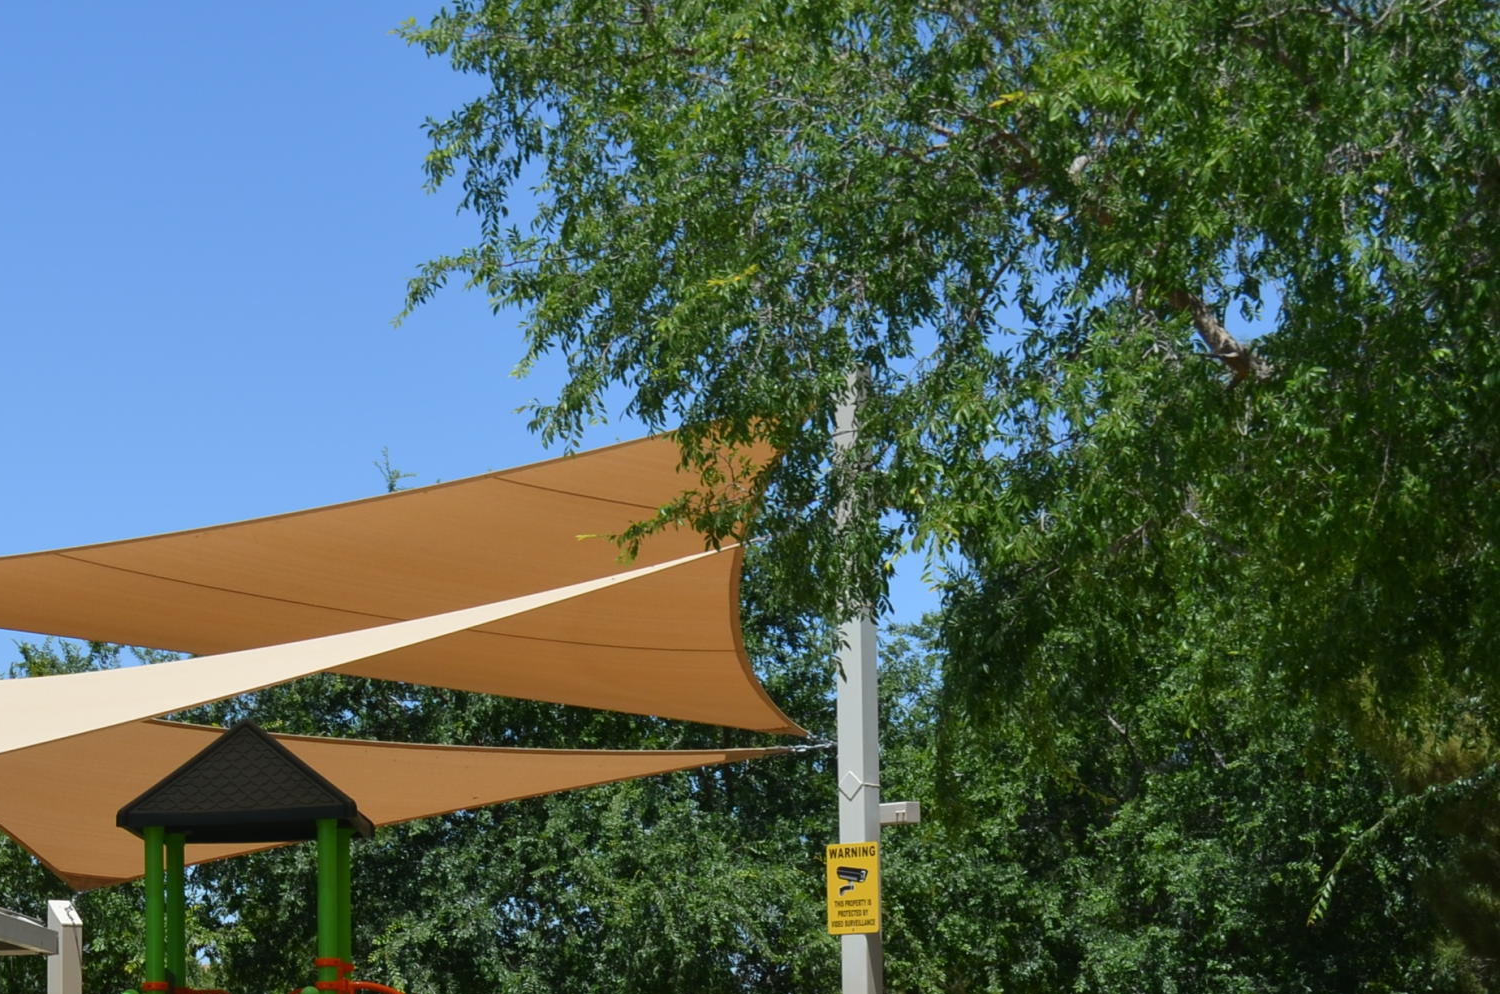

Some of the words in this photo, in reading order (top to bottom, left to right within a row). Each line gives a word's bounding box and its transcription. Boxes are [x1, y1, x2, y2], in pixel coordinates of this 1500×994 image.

[828, 845, 877, 859] WARNING
[845, 899, 867, 907] PROPERTY
[845, 919, 876, 927] SURVEILLANCE
